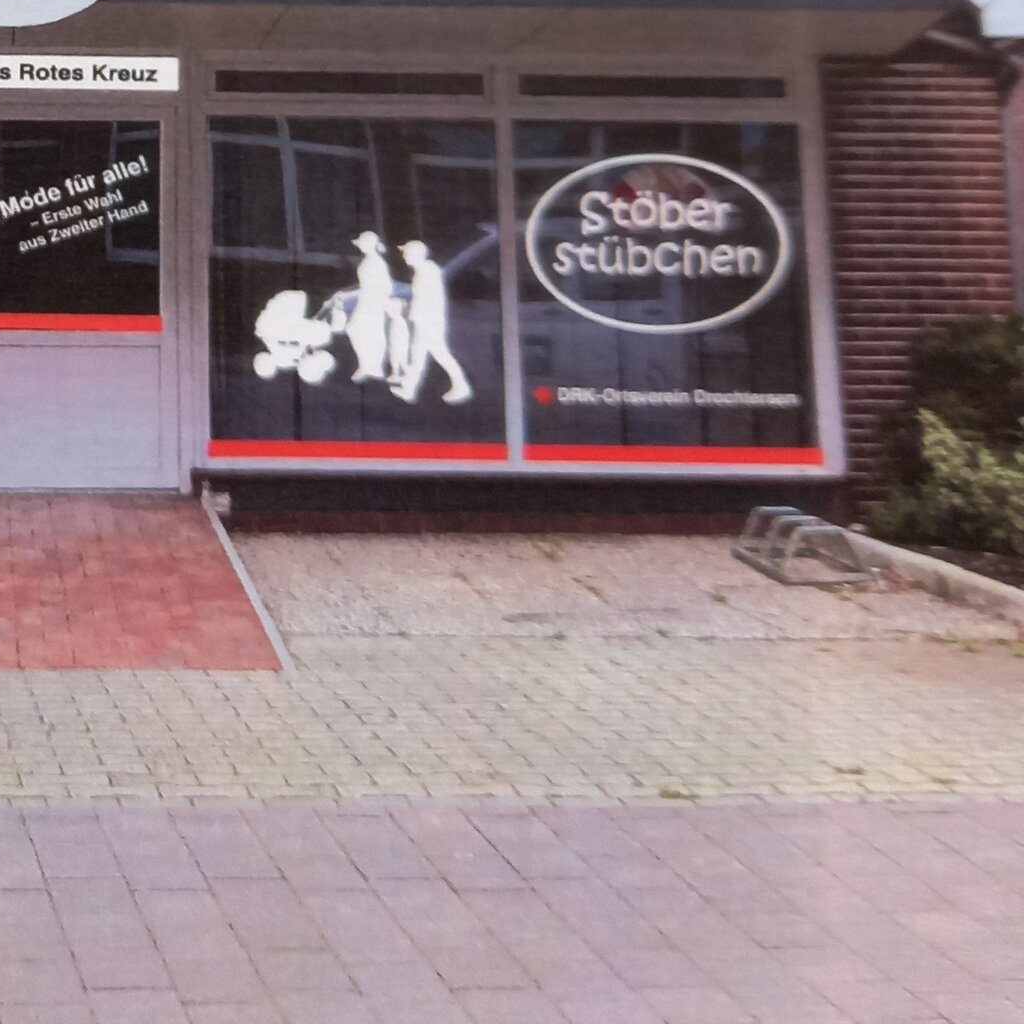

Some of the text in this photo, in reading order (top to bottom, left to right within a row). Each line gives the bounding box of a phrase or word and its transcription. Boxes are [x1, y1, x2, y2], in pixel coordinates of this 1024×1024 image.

[19, 63, 83, 82] Rotes
[92, 65, 158, 82] Kreuz
[64, 173, 96, 196] für
[102, 154, 149, 184] alle!
[18, 200, 149, 253] aus Zweiter Hand
[42, 204, 82, 225] Erste
[83, 189, 123, 211] Wahl
[579, 189, 734, 236] Stöber
